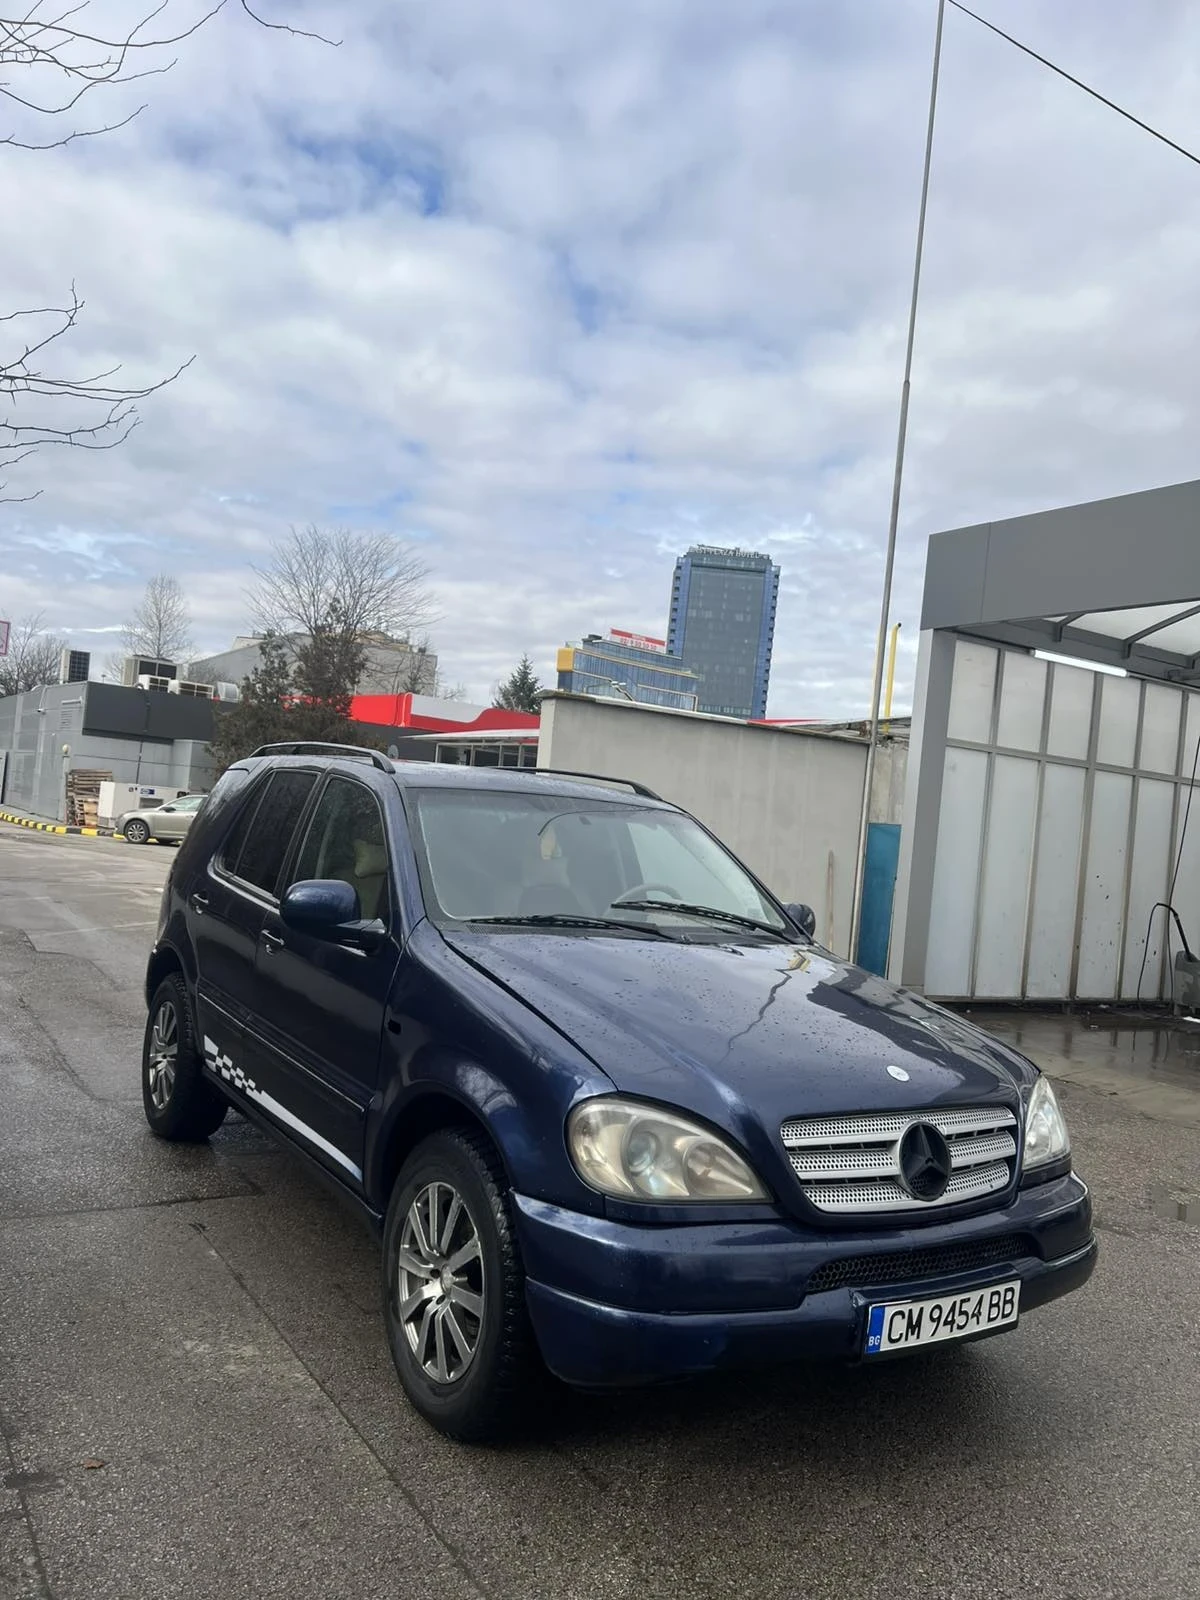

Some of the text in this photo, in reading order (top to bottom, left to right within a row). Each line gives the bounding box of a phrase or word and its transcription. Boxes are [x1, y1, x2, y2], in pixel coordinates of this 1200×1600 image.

[735, 549, 760, 559] HOTEL
[887, 1286, 1015, 1344] CM 9454 BB
[868, 1335, 880, 1346] BG
